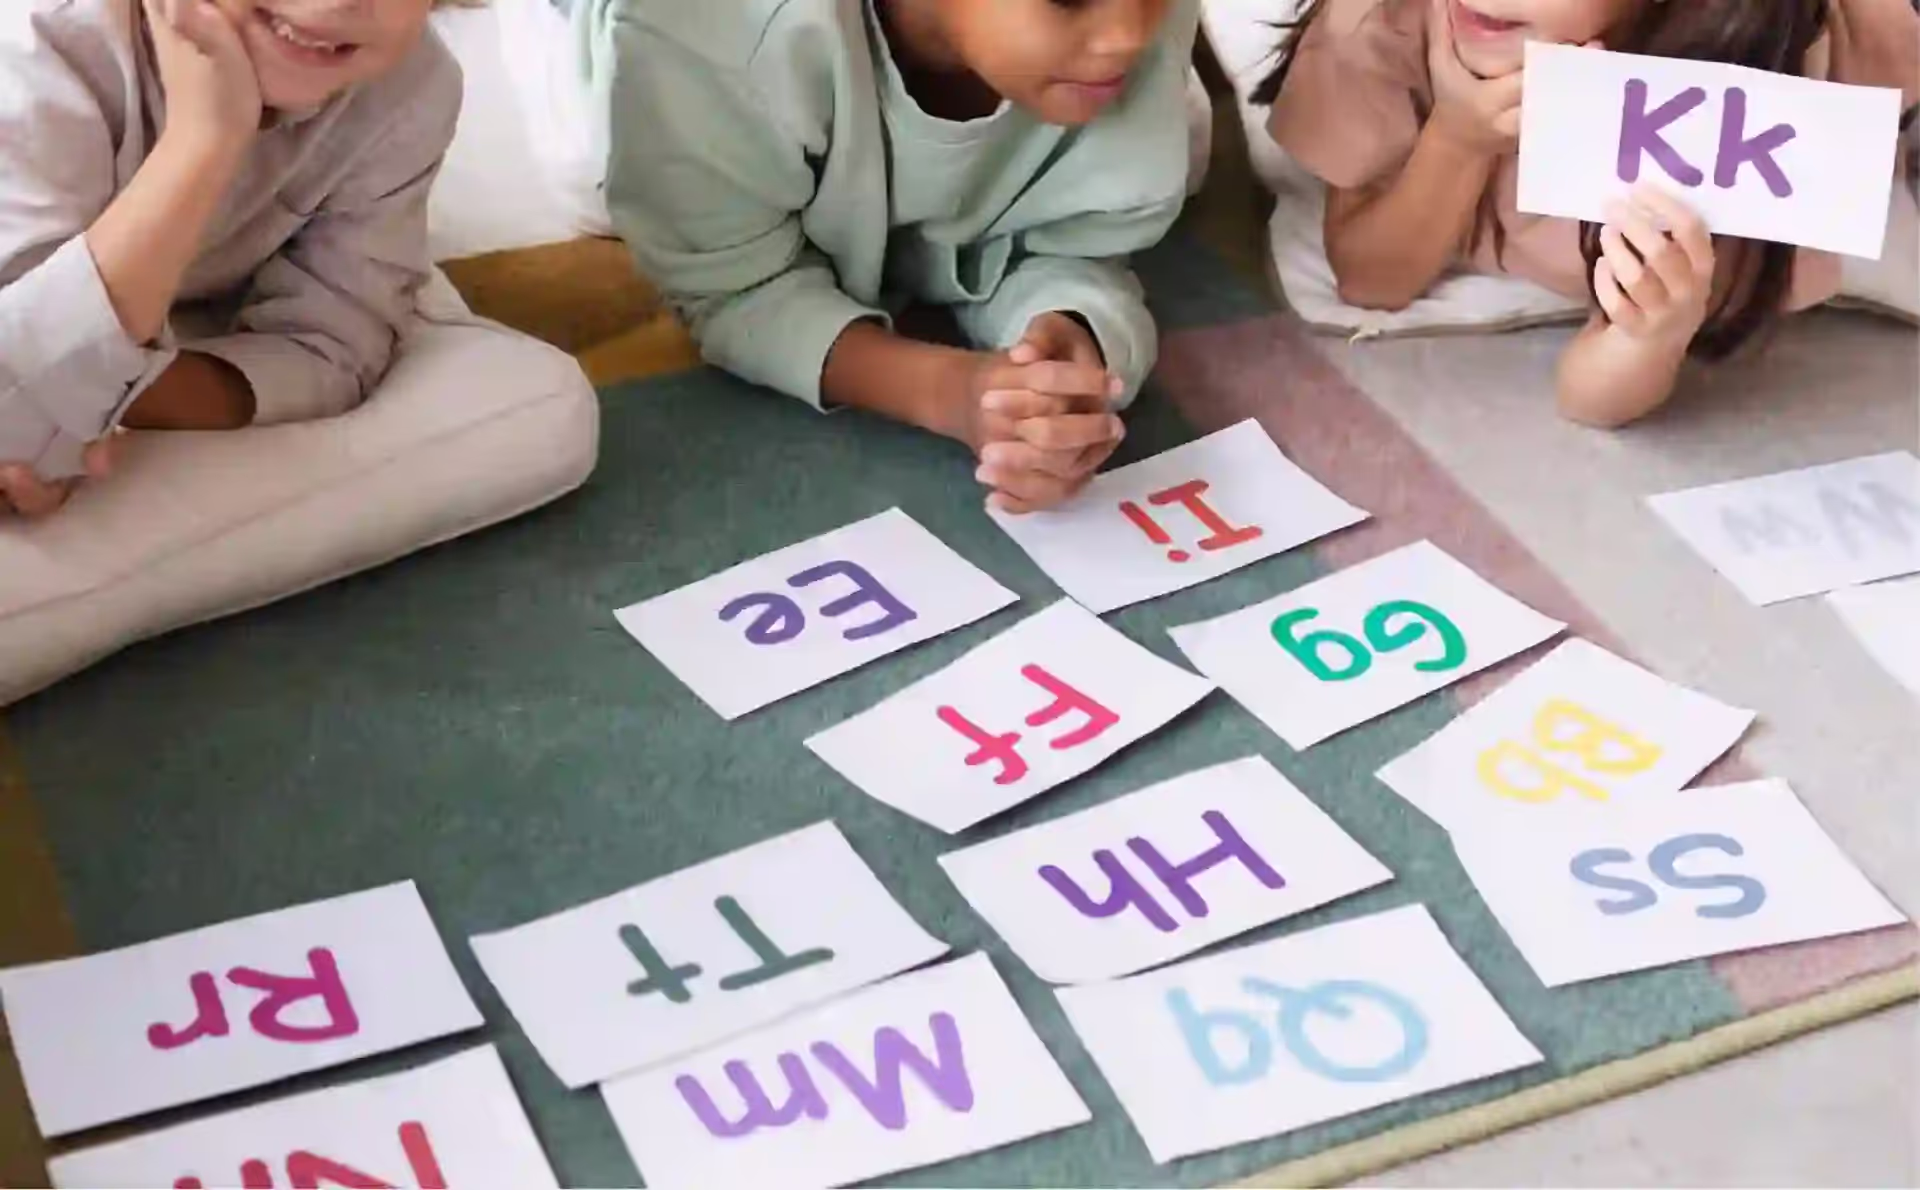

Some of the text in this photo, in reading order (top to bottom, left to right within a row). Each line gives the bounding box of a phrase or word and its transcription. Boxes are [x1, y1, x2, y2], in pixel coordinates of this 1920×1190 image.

[1617, 78, 1797, 198] Kk
[1118, 478, 1264, 564] Ii
[718, 559, 918, 646] Ee
[1268, 598, 1470, 684] Gg
[935, 662, 1121, 785] Ff
[1475, 698, 1664, 804] Bb
[1037, 809, 1287, 933] Hh
[1569, 832, 1767, 919] Ss
[146, 946, 361, 1053] Rr
[617, 894, 836, 1004] Tt
[675, 1011, 975, 1139] Mm
[1163, 976, 1430, 1086] Qq
